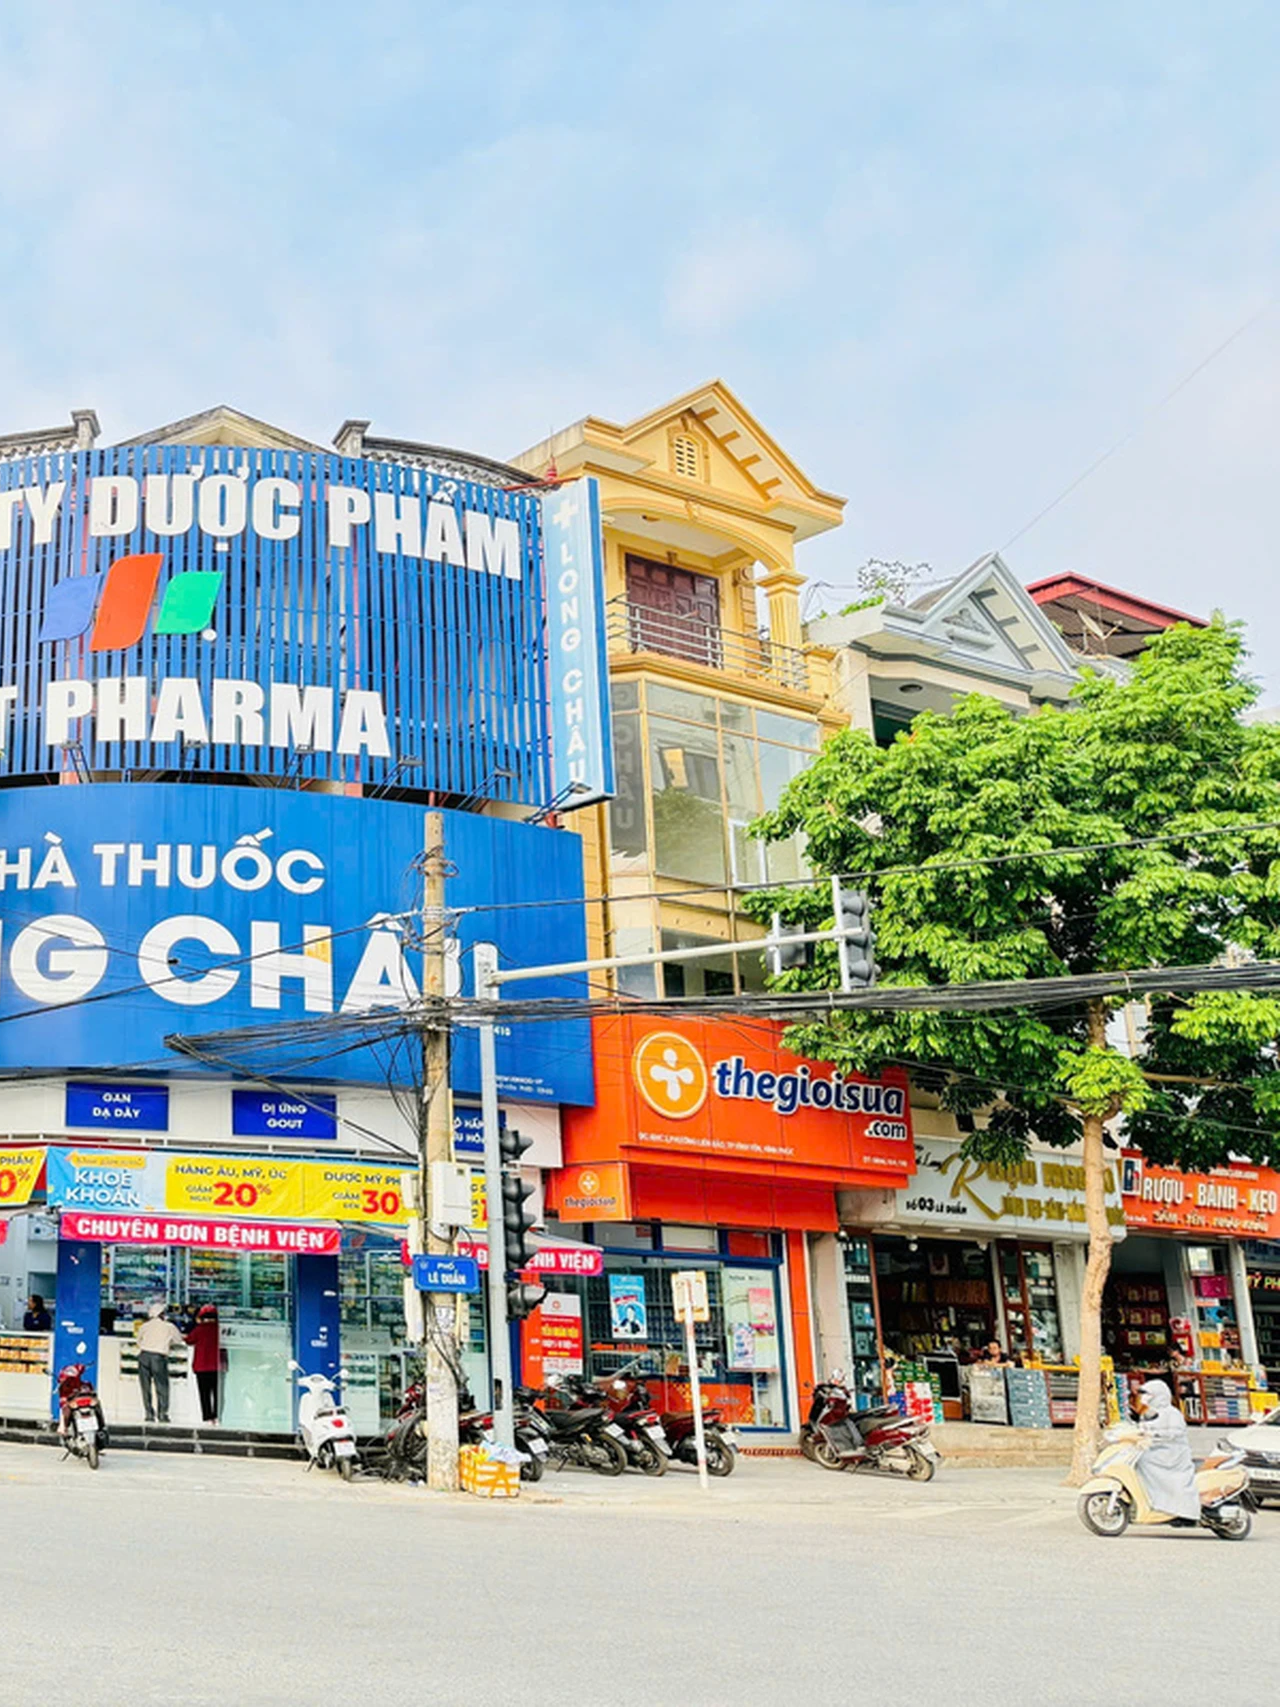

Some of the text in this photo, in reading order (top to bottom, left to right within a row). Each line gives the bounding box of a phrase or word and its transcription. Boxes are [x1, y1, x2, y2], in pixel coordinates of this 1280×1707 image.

[89, 465, 301, 551] DƯỢC
[329, 479, 522, 581] PHẨM
[558, 542, 582, 652] LONG
[47, 676, 391, 758] PHARMA
[93, 826, 326, 894] THUỐC
[713, 1056, 906, 1116] thegioisua
[266, 1117, 304, 1130] GOUT
[864, 1119, 907, 1140] .com
[175, 1163, 287, 1180] HÀNG ÂU, MỸ, ÚC
[213, 1181, 272, 1208] 20%
[918, 1196, 935, 1212] 03
[1142, 1176, 1184, 1209] RƯỢU
[1197, 1179, 1238, 1211] BÁNH
[1248, 1187, 1278, 1220] KẸO
[77, 1217, 325, 1252] CHUYÊN ĐƠN BỆNH VIỆN
[437, 1261, 455, 1271] PHỐ
[558, 1250, 595, 1274] VIỆN
[427, 1271, 440, 1284] LÊ
